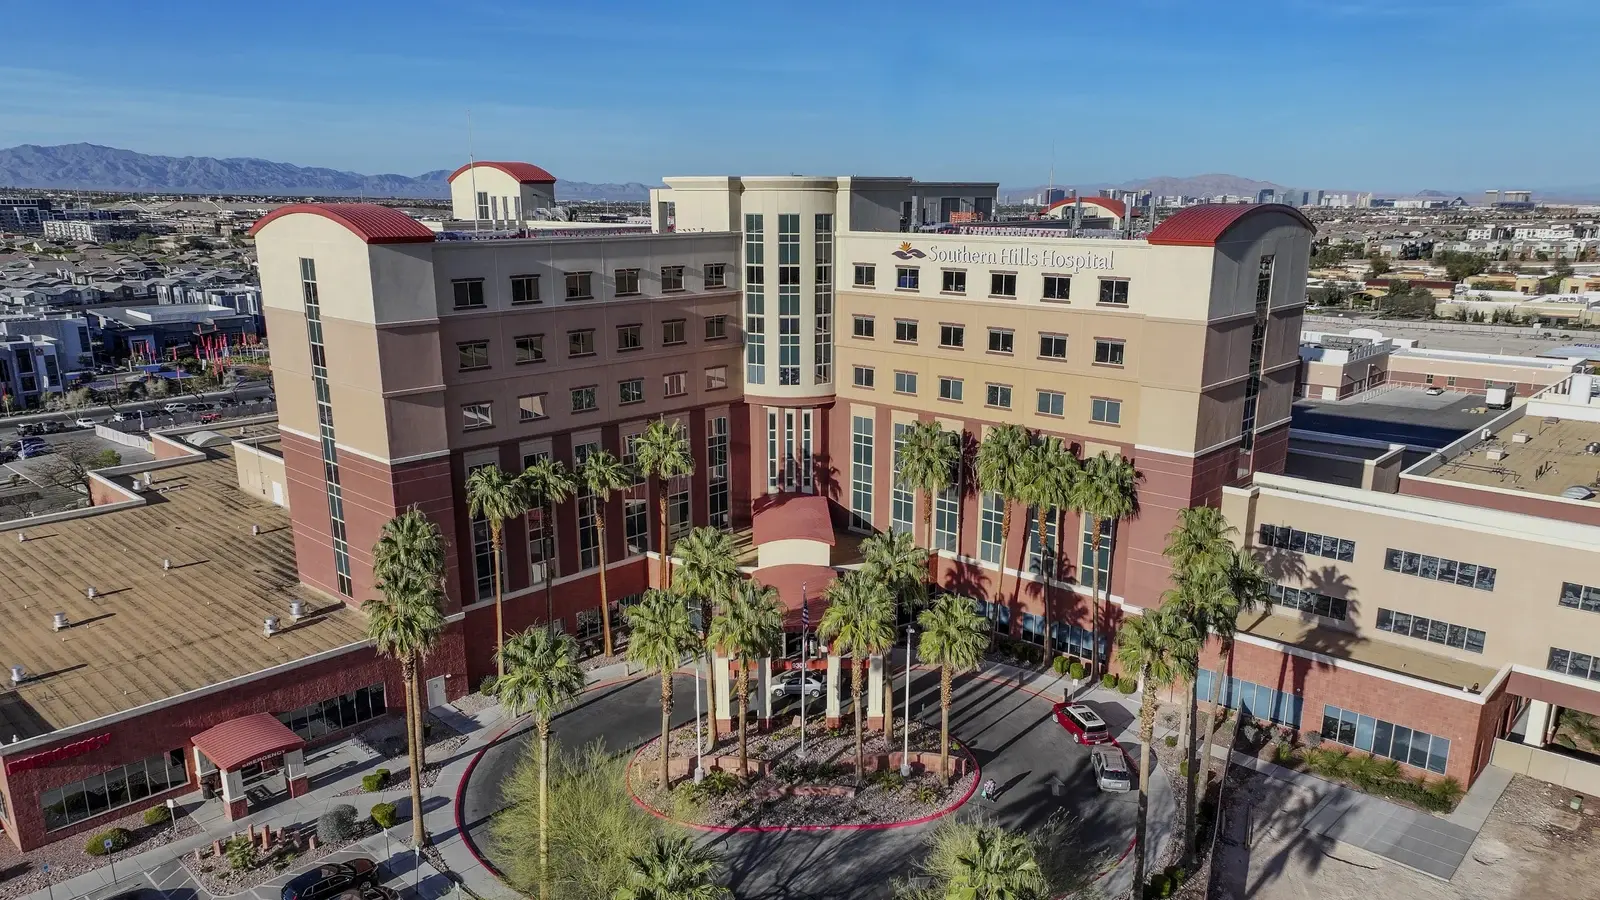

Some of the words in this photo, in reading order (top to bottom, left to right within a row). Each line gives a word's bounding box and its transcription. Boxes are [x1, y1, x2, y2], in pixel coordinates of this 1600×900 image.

[928, 244, 997, 265] Southern
[1000, 247, 1038, 266] Hills
[1041, 250, 1115, 275] Hospital
[241, 749, 286, 768] EMERGENCY
